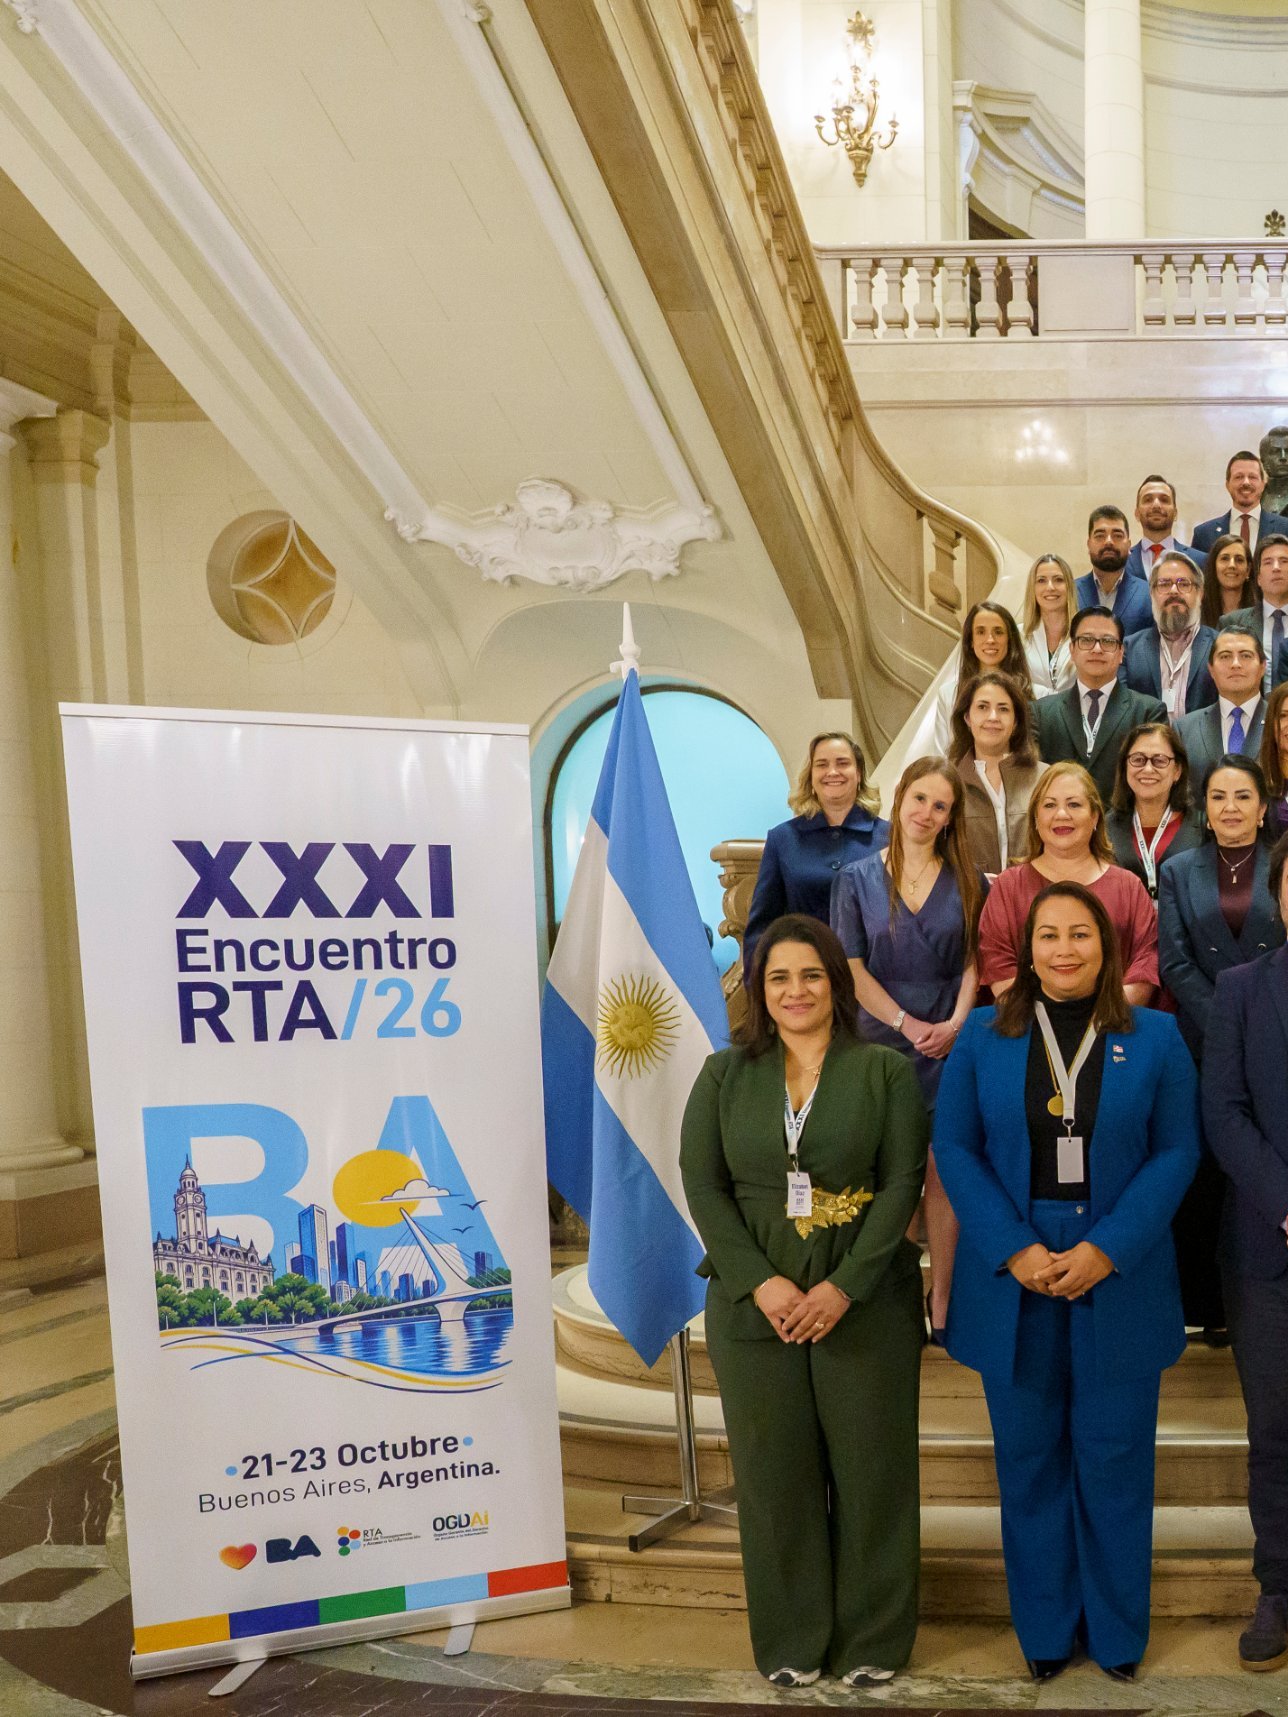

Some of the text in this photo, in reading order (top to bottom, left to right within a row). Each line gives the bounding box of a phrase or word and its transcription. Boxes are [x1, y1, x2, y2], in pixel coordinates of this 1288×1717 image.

[172, 840, 455, 918] XXXI
[175, 928, 457, 973] Encuentro
[177, 977, 462, 1044] RTA/26
[241, 1435, 459, 1480] 21-23 Octubre
[198, 1460, 501, 1513] Buenos Aires, Argentina.
[265, 1534, 321, 1563] BA
[363, 1527, 383, 1539] RTA
